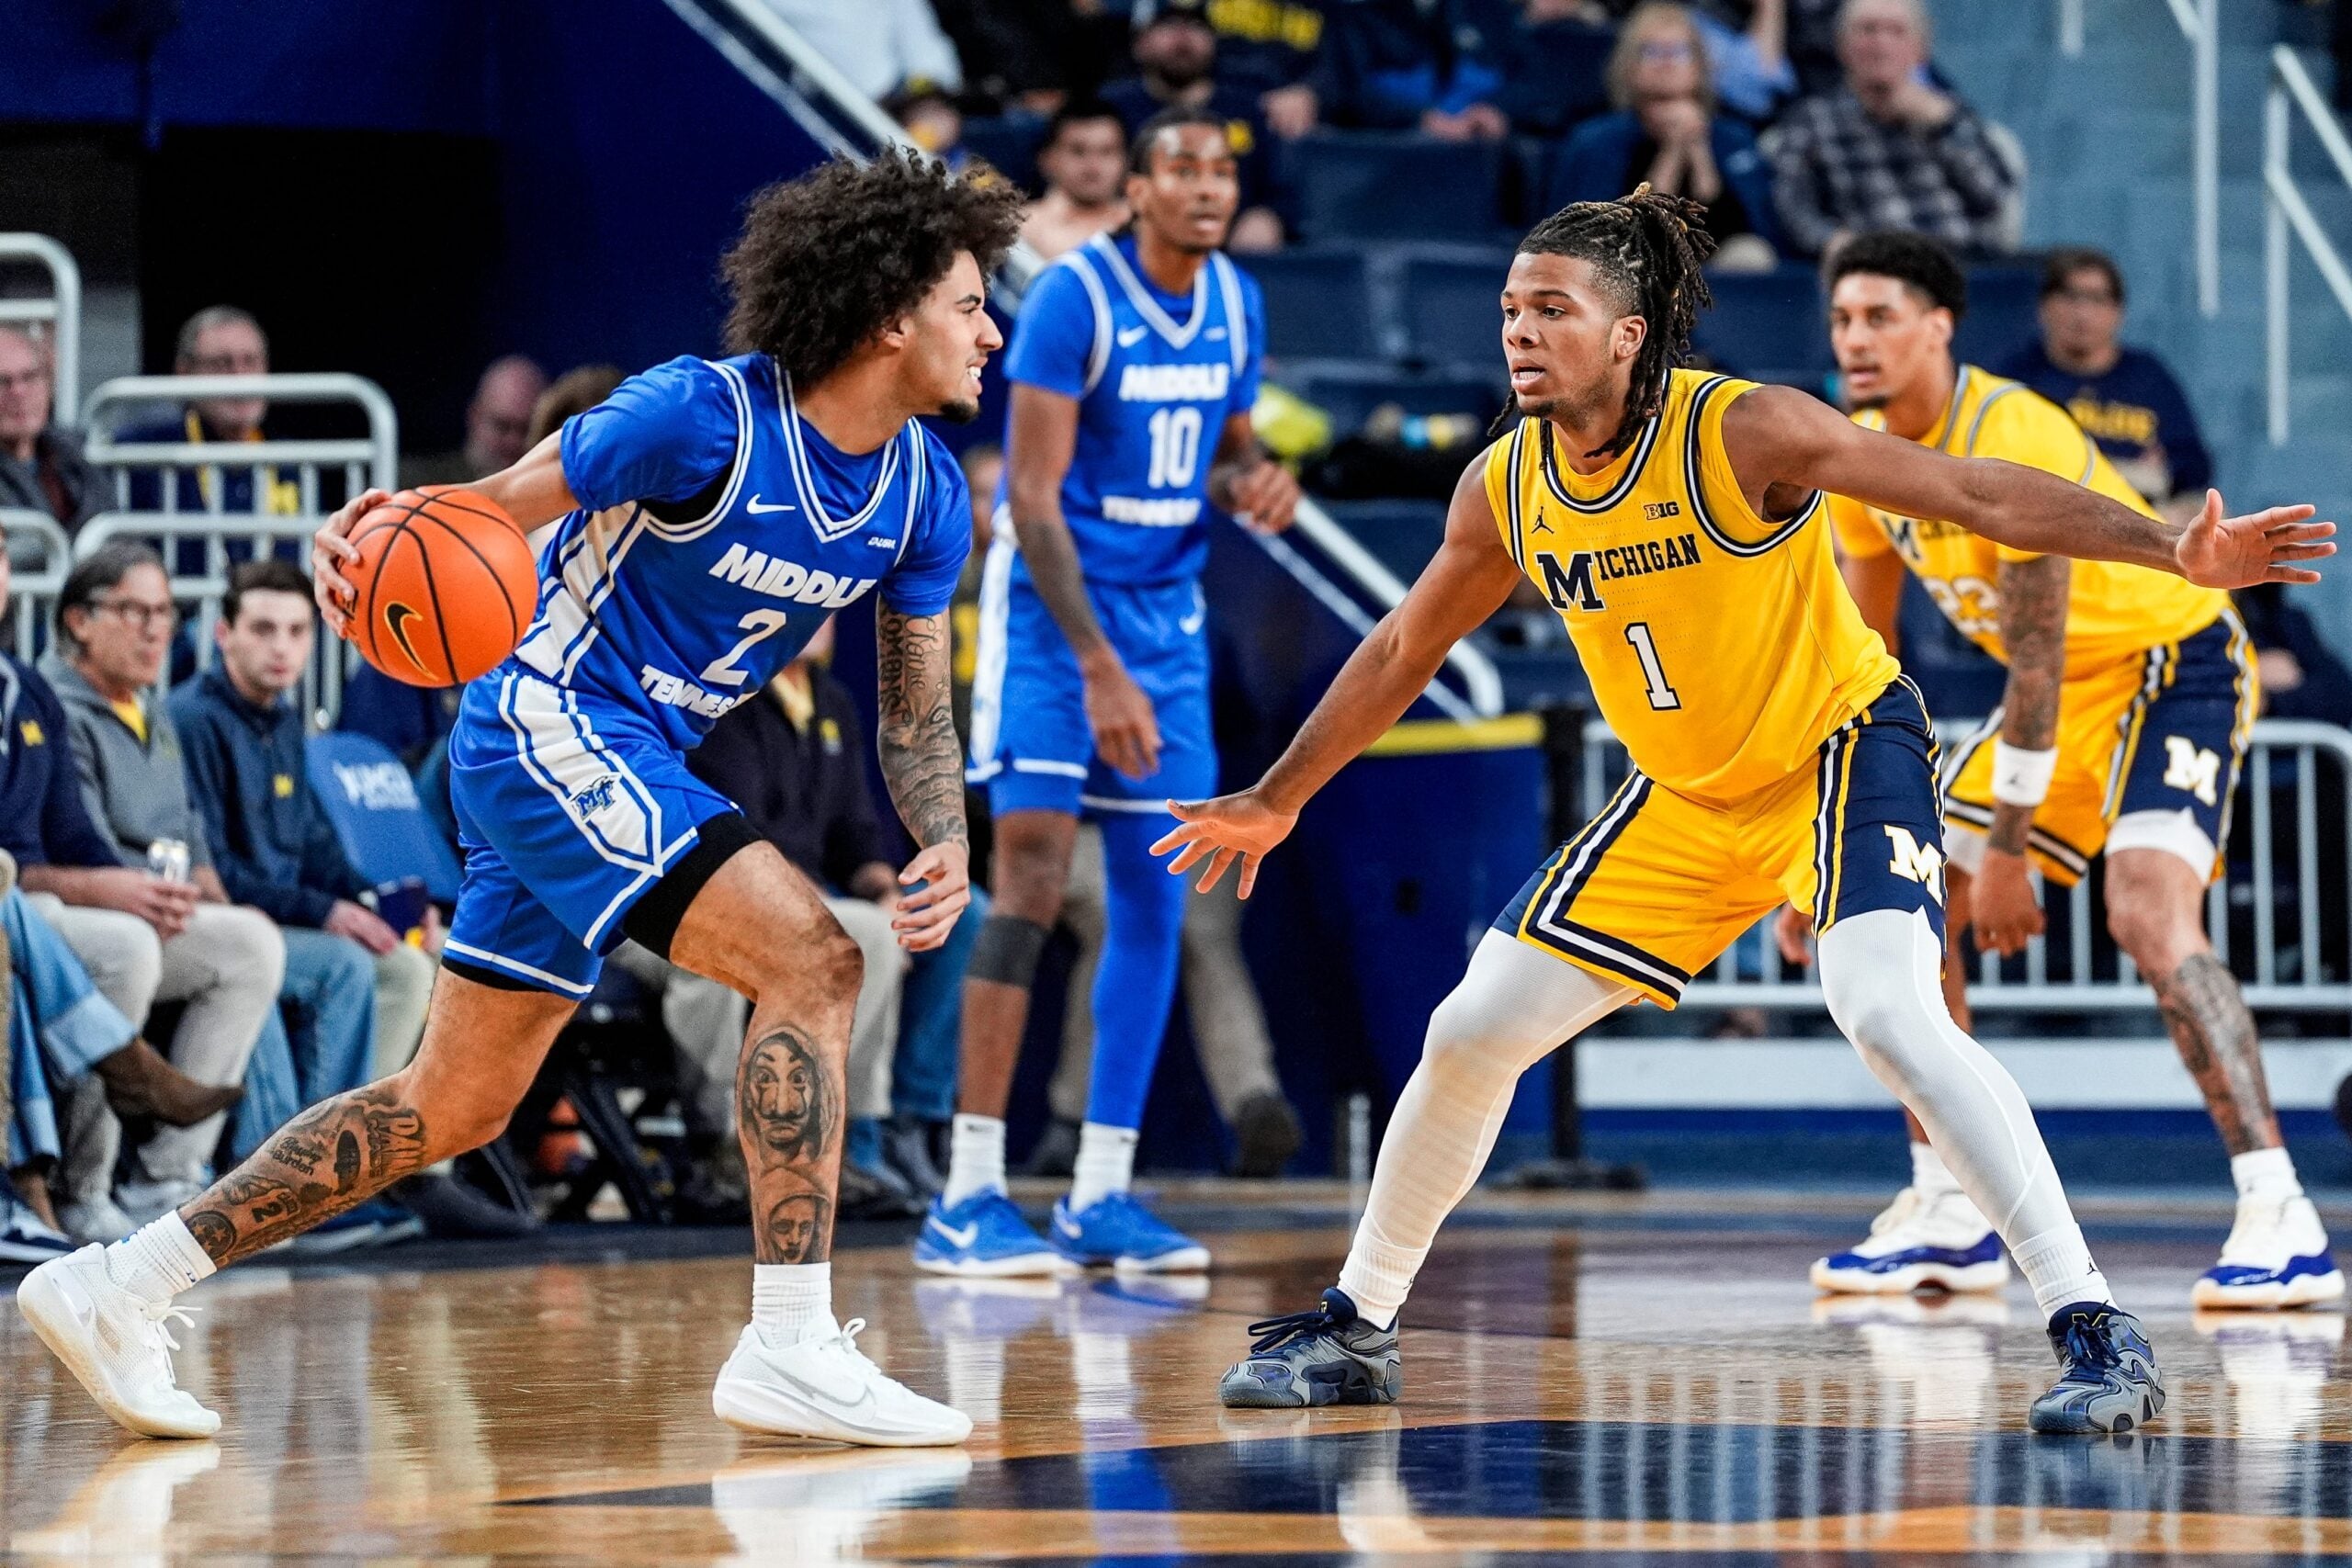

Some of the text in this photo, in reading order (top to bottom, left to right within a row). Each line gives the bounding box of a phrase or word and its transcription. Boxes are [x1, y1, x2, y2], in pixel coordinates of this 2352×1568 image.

[1148, 406, 1203, 489] 10
[1535, 534, 1702, 612] MICHIGAN
[699, 608, 787, 686] 2
[1623, 622, 1682, 711] 1
[575, 779, 616, 821] MT
[2162, 736, 2222, 807] M
[1883, 824, 1943, 908] M
